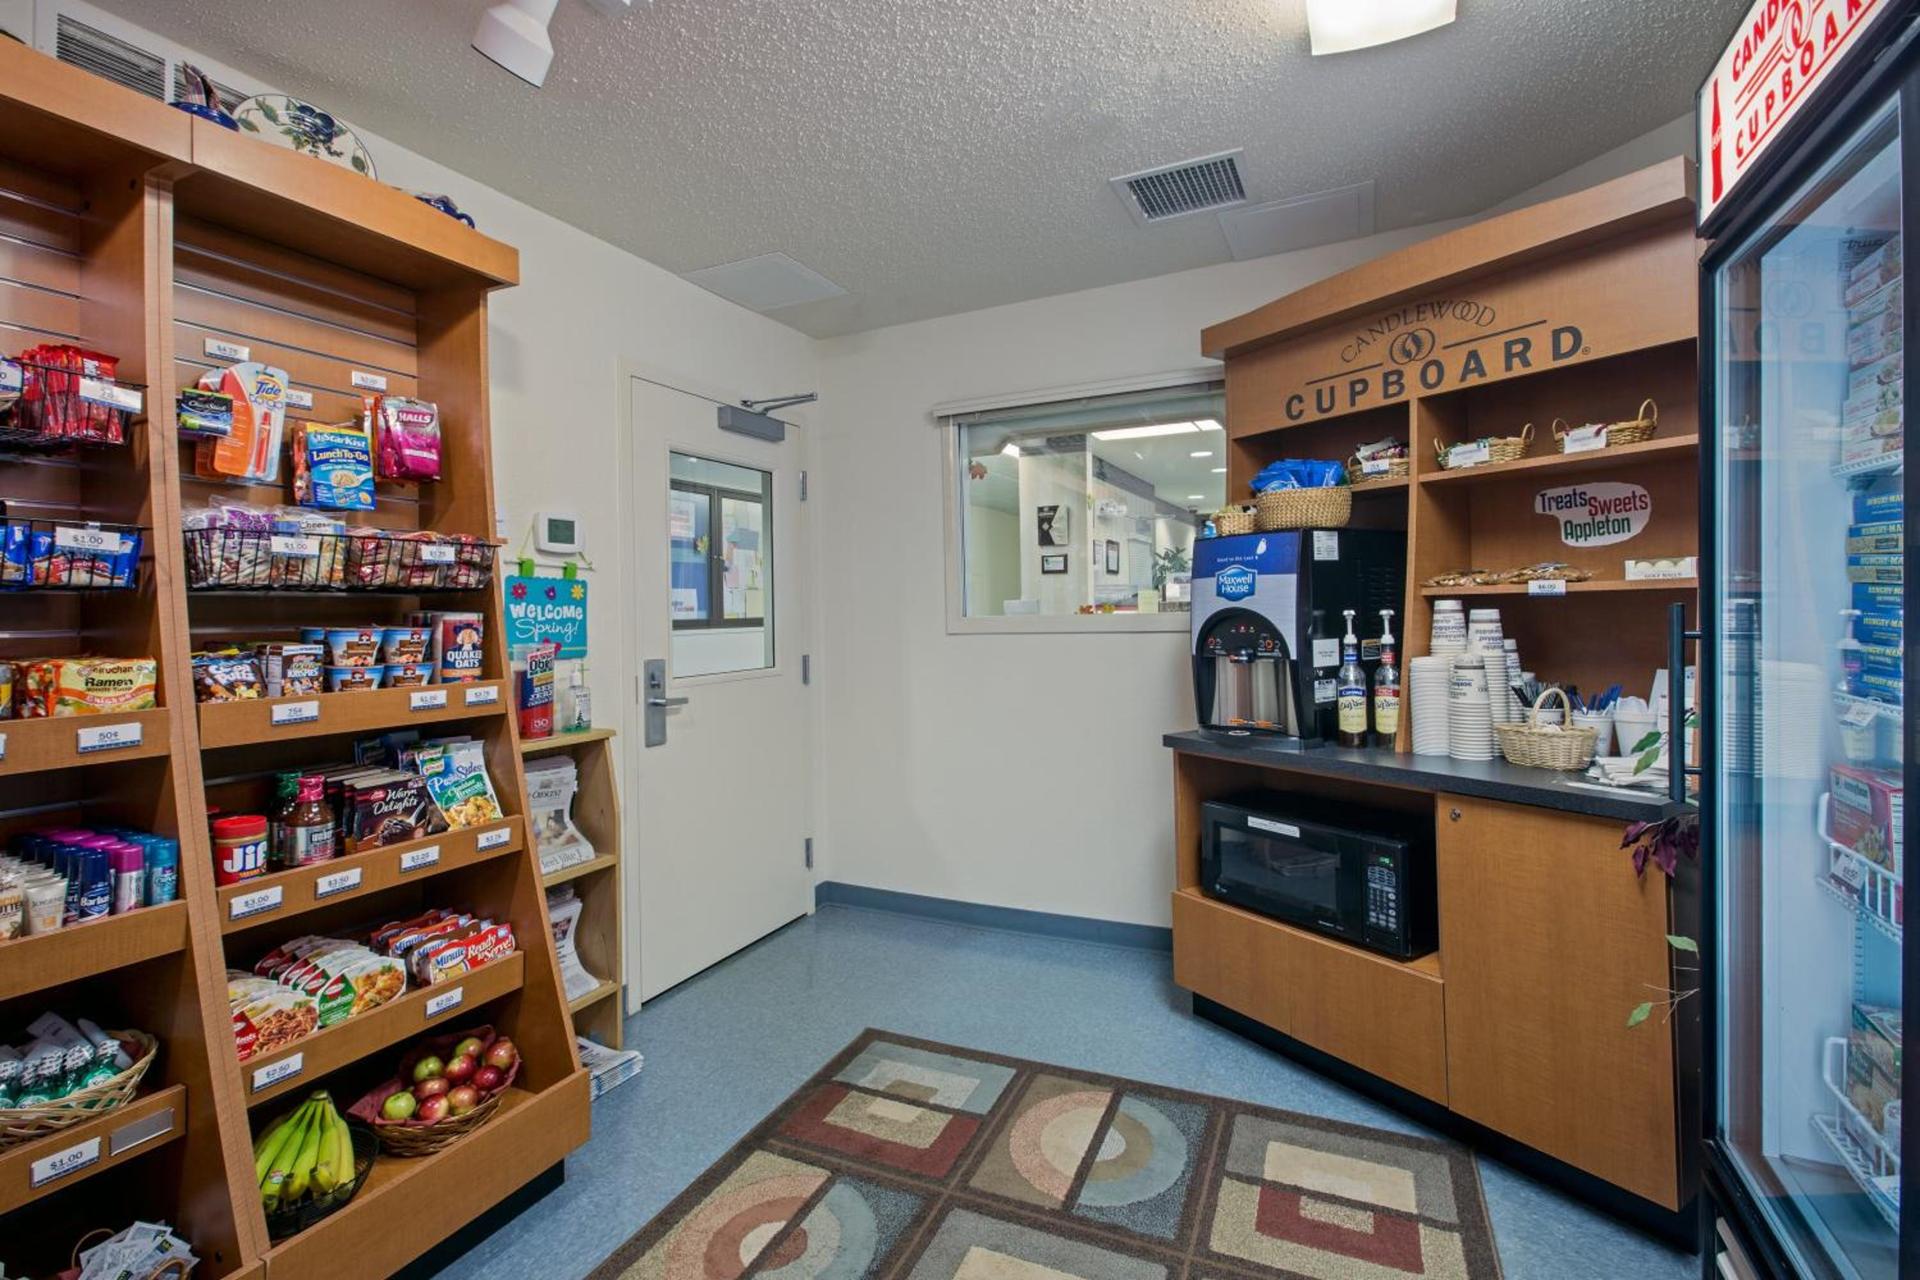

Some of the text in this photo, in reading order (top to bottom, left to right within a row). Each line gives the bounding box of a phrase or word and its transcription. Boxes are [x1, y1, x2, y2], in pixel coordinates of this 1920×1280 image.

[1341, 299, 1495, 363] CANDLEWOOD
[1285, 325, 1583, 420] CUPBOARD
[255, 381, 281, 395] Tide
[398, 411, 431, 422] HALLS
[324, 435, 365, 448] StarKist
[313, 450, 342, 461] Lunch
[1540, 489, 1588, 513] Treats
[1588, 490, 1649, 517] Sweets
[1563, 515, 1631, 542] Appleton
[73, 535, 103, 545] $1.00
[1219, 573, 1252, 586] Maxwell
[1221, 584, 1249, 594] House
[515, 619, 579, 642] Spring!
[455, 660, 480, 668] OATS
[85, 677, 133, 687] Ramen
[99, 731, 118, 740] 50¢
[457, 762, 481, 779] Sides
[387, 788, 417, 801] Warm
[373, 796, 417, 815] Delights
[223, 841, 267, 873] Jif
[468, 933, 496, 959] Ready
[484, 936, 513, 962] Serve!
[435, 946, 465, 966] Minute
[50, 1151, 83, 1171] $1.00
